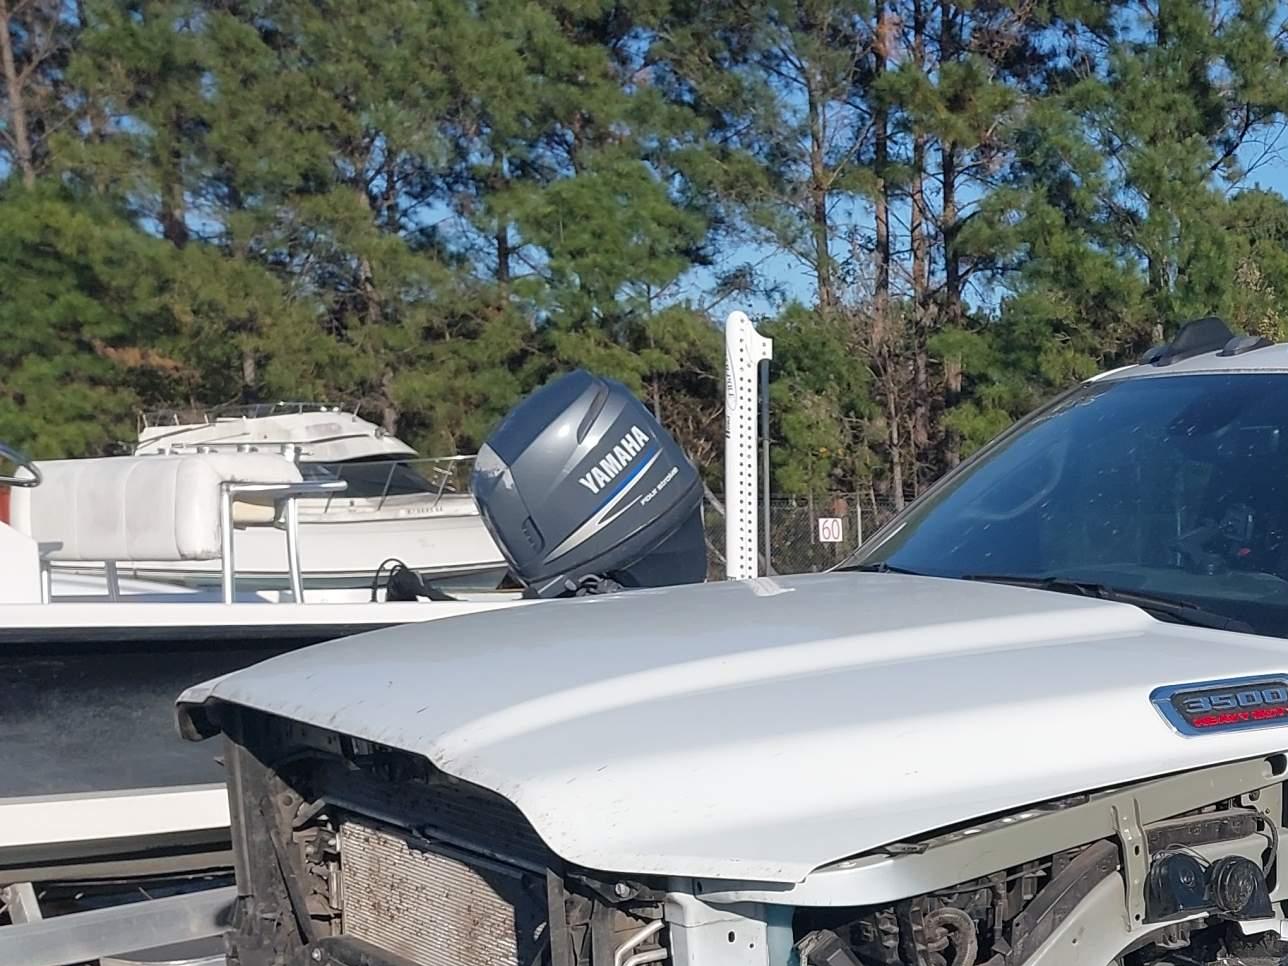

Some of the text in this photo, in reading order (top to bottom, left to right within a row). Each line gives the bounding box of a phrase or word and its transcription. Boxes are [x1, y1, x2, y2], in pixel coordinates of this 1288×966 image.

[578, 425, 650, 495] YAMAHA
[822, 519, 840, 540] 60
[1183, 688, 1288, 713] 3500
